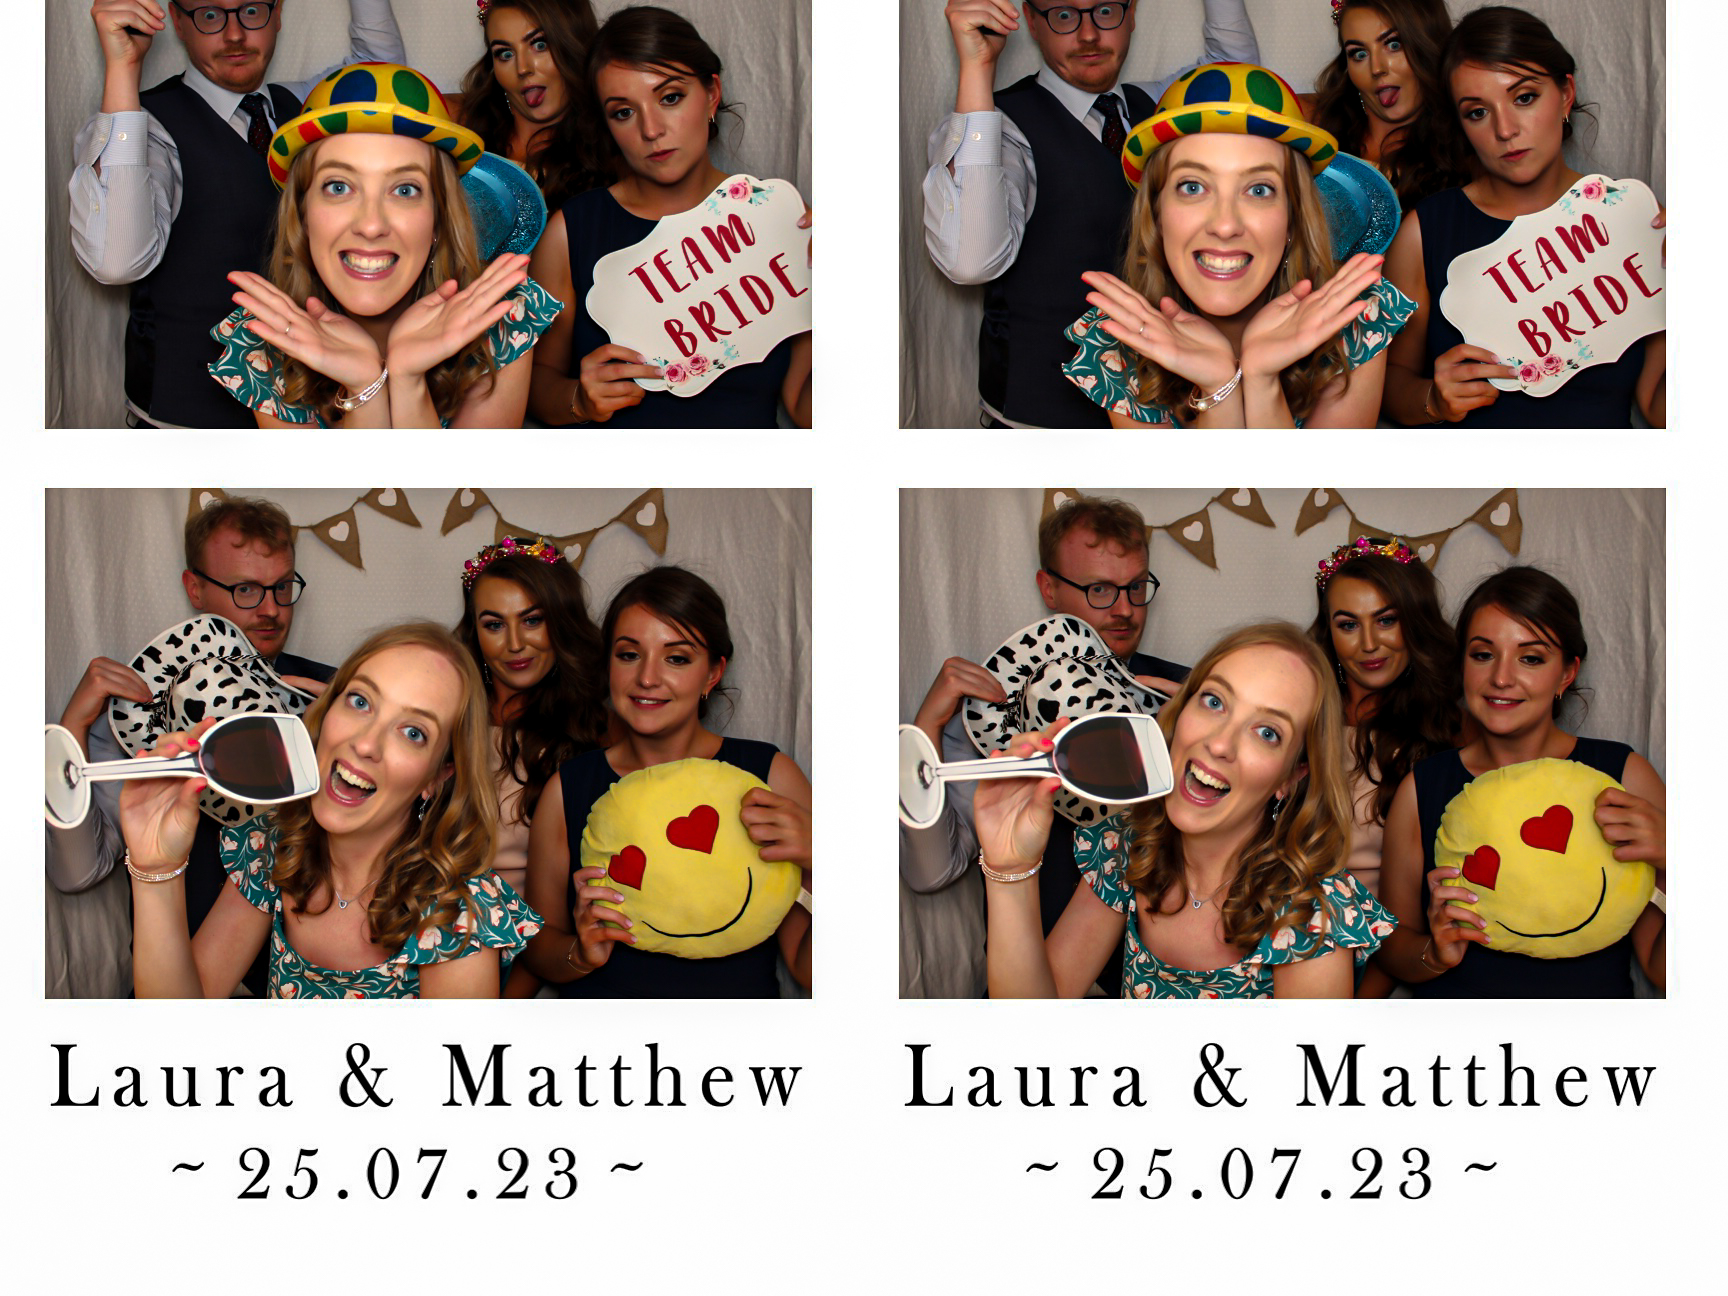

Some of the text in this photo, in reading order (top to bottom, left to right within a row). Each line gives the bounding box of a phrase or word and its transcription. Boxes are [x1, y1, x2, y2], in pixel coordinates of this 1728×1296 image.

[628, 213, 755, 304] TEAM
[663, 252, 809, 358] BRIDE
[1482, 213, 1609, 304] TEAM
[1517, 252, 1663, 358] BRIDE
